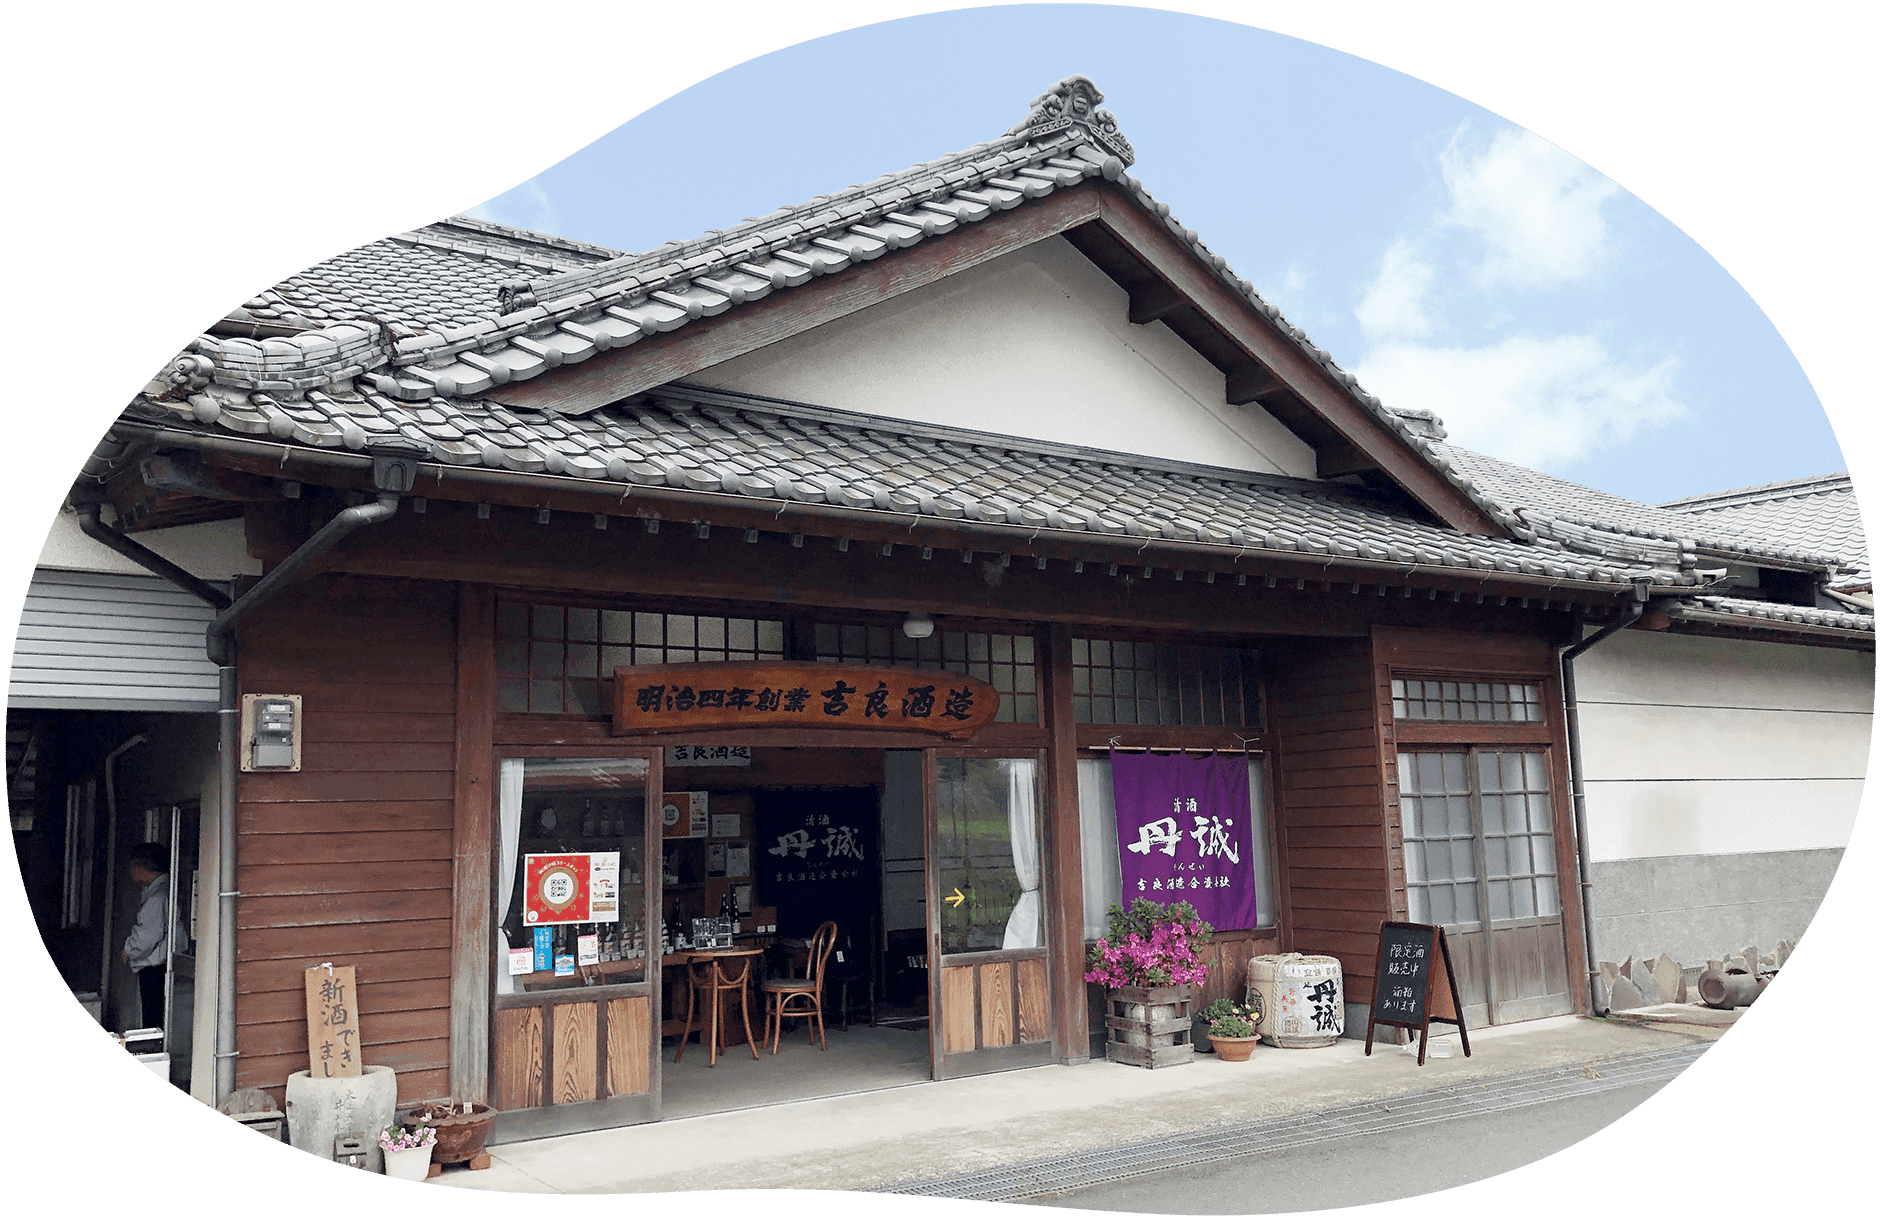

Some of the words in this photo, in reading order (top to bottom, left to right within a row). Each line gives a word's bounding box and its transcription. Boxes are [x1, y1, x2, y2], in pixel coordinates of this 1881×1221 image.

[636, 684, 810, 713] 明治四年創業
[820, 681, 975, 720] 吉良酒造
[675, 745, 751, 760] 吉良酒造
[768, 826, 864, 860] 丹誠
[1127, 815, 1240, 864] 丹誠
[1389, 942, 1425, 959] 限定酒
[1387, 962, 1419, 977] 販売中
[319, 978, 348, 1026] 新酒
[1392, 986, 1413, 998] 酒粕
[1307, 979, 1341, 1034] 丹誠
[1383, 999, 1417, 1013] あります
